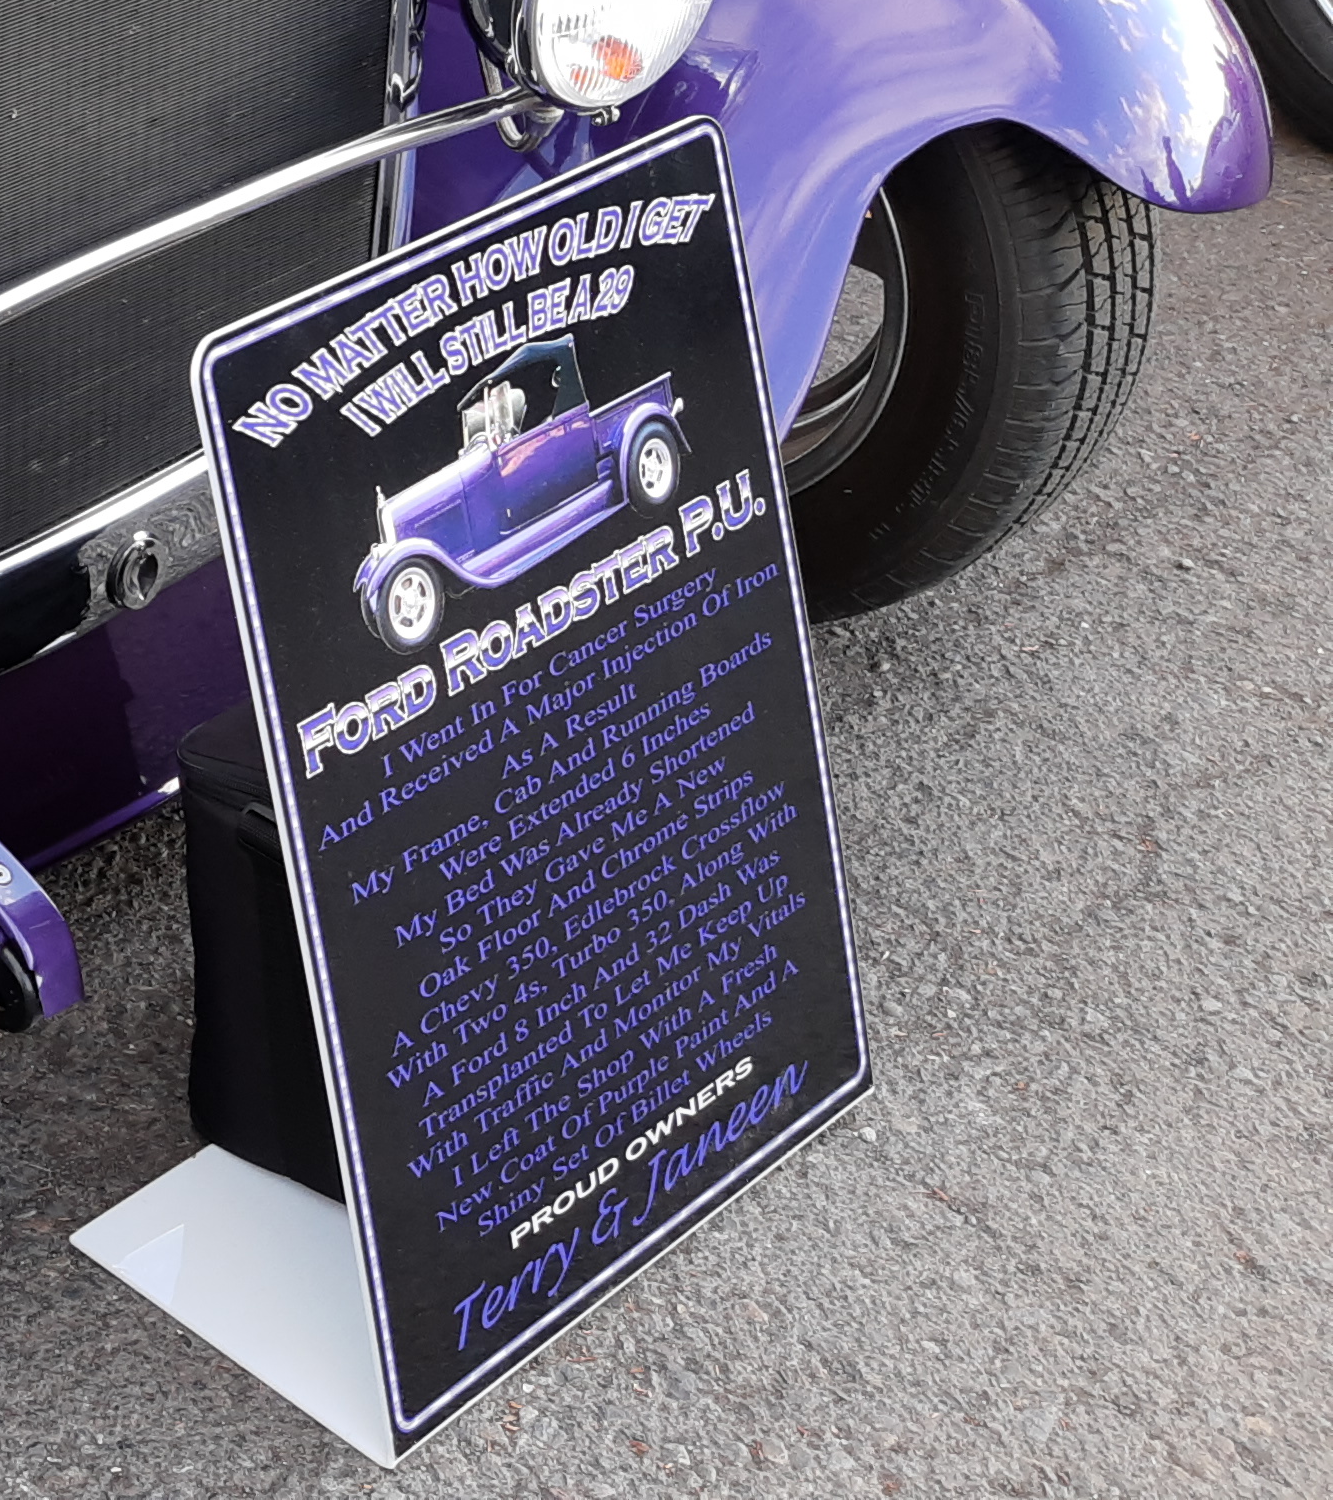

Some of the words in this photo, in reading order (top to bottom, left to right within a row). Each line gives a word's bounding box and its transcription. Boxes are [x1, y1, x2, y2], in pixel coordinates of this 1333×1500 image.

[232, 384, 314, 447] NO
[291, 274, 458, 400] MATTER
[451, 224, 547, 307] HOW
[549, 205, 622, 266] OLD
[620, 200, 644, 249] I
[639, 193, 716, 246] GET
[352, 350, 451, 424] WILL
[440, 301, 527, 375] STILL
[527, 277, 571, 338] BE
[568, 273, 593, 324] A
[591, 264, 635, 320] 29
[339, 402, 382, 437] I
[296, 664, 437, 780] FORD
[440, 524, 678, 697] ROADSTER
[678, 468, 766, 558] P.U.
[319, 800, 375, 851] And
[378, 728, 495, 815] Received
[499, 717, 521, 744] A
[525, 672, 596, 725] Major
[601, 612, 698, 679] Injection
[702, 583, 731, 617] Of
[734, 563, 780, 599] Iron
[383, 754, 394, 779] I
[398, 715, 465, 763] Went
[471, 700, 498, 726] In
[501, 670, 543, 707] For
[549, 620, 627, 677] Cancer
[633, 567, 716, 628] Surgery
[502, 748, 534, 780] As
[540, 732, 559, 757] A
[565, 683, 637, 739] Result
[351, 865, 395, 906] My
[401, 815, 490, 874] Frame,
[494, 774, 542, 814] Cab
[548, 736, 597, 785] And
[601, 681, 697, 749] Running
[698, 631, 773, 688] Boards
[393, 909, 437, 949] My
[444, 868, 496, 916] Bed
[498, 841, 550, 877] Was
[555, 778, 643, 847] Already
[649, 700, 756, 785] Shortened
[418, 955, 472, 998] Oak
[477, 909, 542, 963] Floor
[548, 869, 597, 918] And
[601, 813, 689, 879] Chrome
[693, 770, 754, 819] Strips
[438, 835, 502, 881] Were
[508, 757, 616, 841] Extended
[621, 745, 636, 768] 6
[641, 706, 711, 756] Inches
[439, 923, 473, 955] So
[476, 879, 537, 925] They
[545, 837, 605, 883] Gave
[610, 809, 648, 842] Me
[654, 792, 673, 816] A
[676, 757, 725, 799] New
[386, 1041, 449, 1089] With
[453, 1003, 507, 1045] Two
[514, 980, 548, 1004] 4s,
[550, 927, 621, 979] Turbo
[627, 889, 675, 931] 350,
[681, 842, 745, 895] Along
[747, 803, 798, 843] With
[392, 1030, 415, 1058] A
[420, 974, 498, 1034] Chevy
[506, 936, 558, 980] 350,
[563, 855, 678, 942] Edlebrock
[681, 781, 785, 860] Crossflow
[406, 1130, 469, 1179] With
[473, 1072, 553, 1133] Traffic
[561, 1027, 609, 1077] And
[613, 966, 701, 1039] Monitor
[706, 941, 740, 971] My
[747, 892, 806, 938] Vitals
[418, 1019, 573, 1139] Transplanted
[577, 1003, 608, 1028] To
[614, 969, 651, 1007] Let
[655, 943, 692, 976] Me
[698, 900, 752, 947] Keep
[757, 875, 789, 903] Up
[422, 1081, 445, 1108] A
[451, 1031, 509, 1087] Ford
[514, 1018, 530, 1042] 8
[535, 982, 588, 1028] Inch
[593, 942, 640, 991] And
[646, 920, 672, 953] 32
[678, 882, 732, 930] Dash
[736, 853, 781, 885] Was
[435, 1182, 492, 1233] New
[500, 1135, 557, 1184] Coat
[561, 1102, 594, 1140] Of
[598, 1055, 669, 1116] Purple
[675, 1008, 729, 1059] Paint
[734, 970, 777, 1017] And
[782, 959, 800, 982] A
[452, 1165, 464, 1188] I
[470, 1127, 520, 1175] Left
[524, 1095, 571, 1133] The
[577, 1049, 634, 1099] Shop
[638, 1006, 692, 1050] With
[698, 990, 716, 1013] A
[721, 943, 778, 995] Fresh
[477, 1178, 544, 1237] Shiny
[552, 1144, 589, 1181] Set
[594, 1111, 627, 1148] Of
[631, 1070, 691, 1124] Billet
[695, 1012, 773, 1072] Wheels
[509, 1157, 620, 1250] PROUD
[625, 1055, 754, 1161] OWNERS
[453, 1227, 580, 1351] Terry
[591, 1187, 629, 1245] &
[631, 1060, 809, 1226] Janeen
